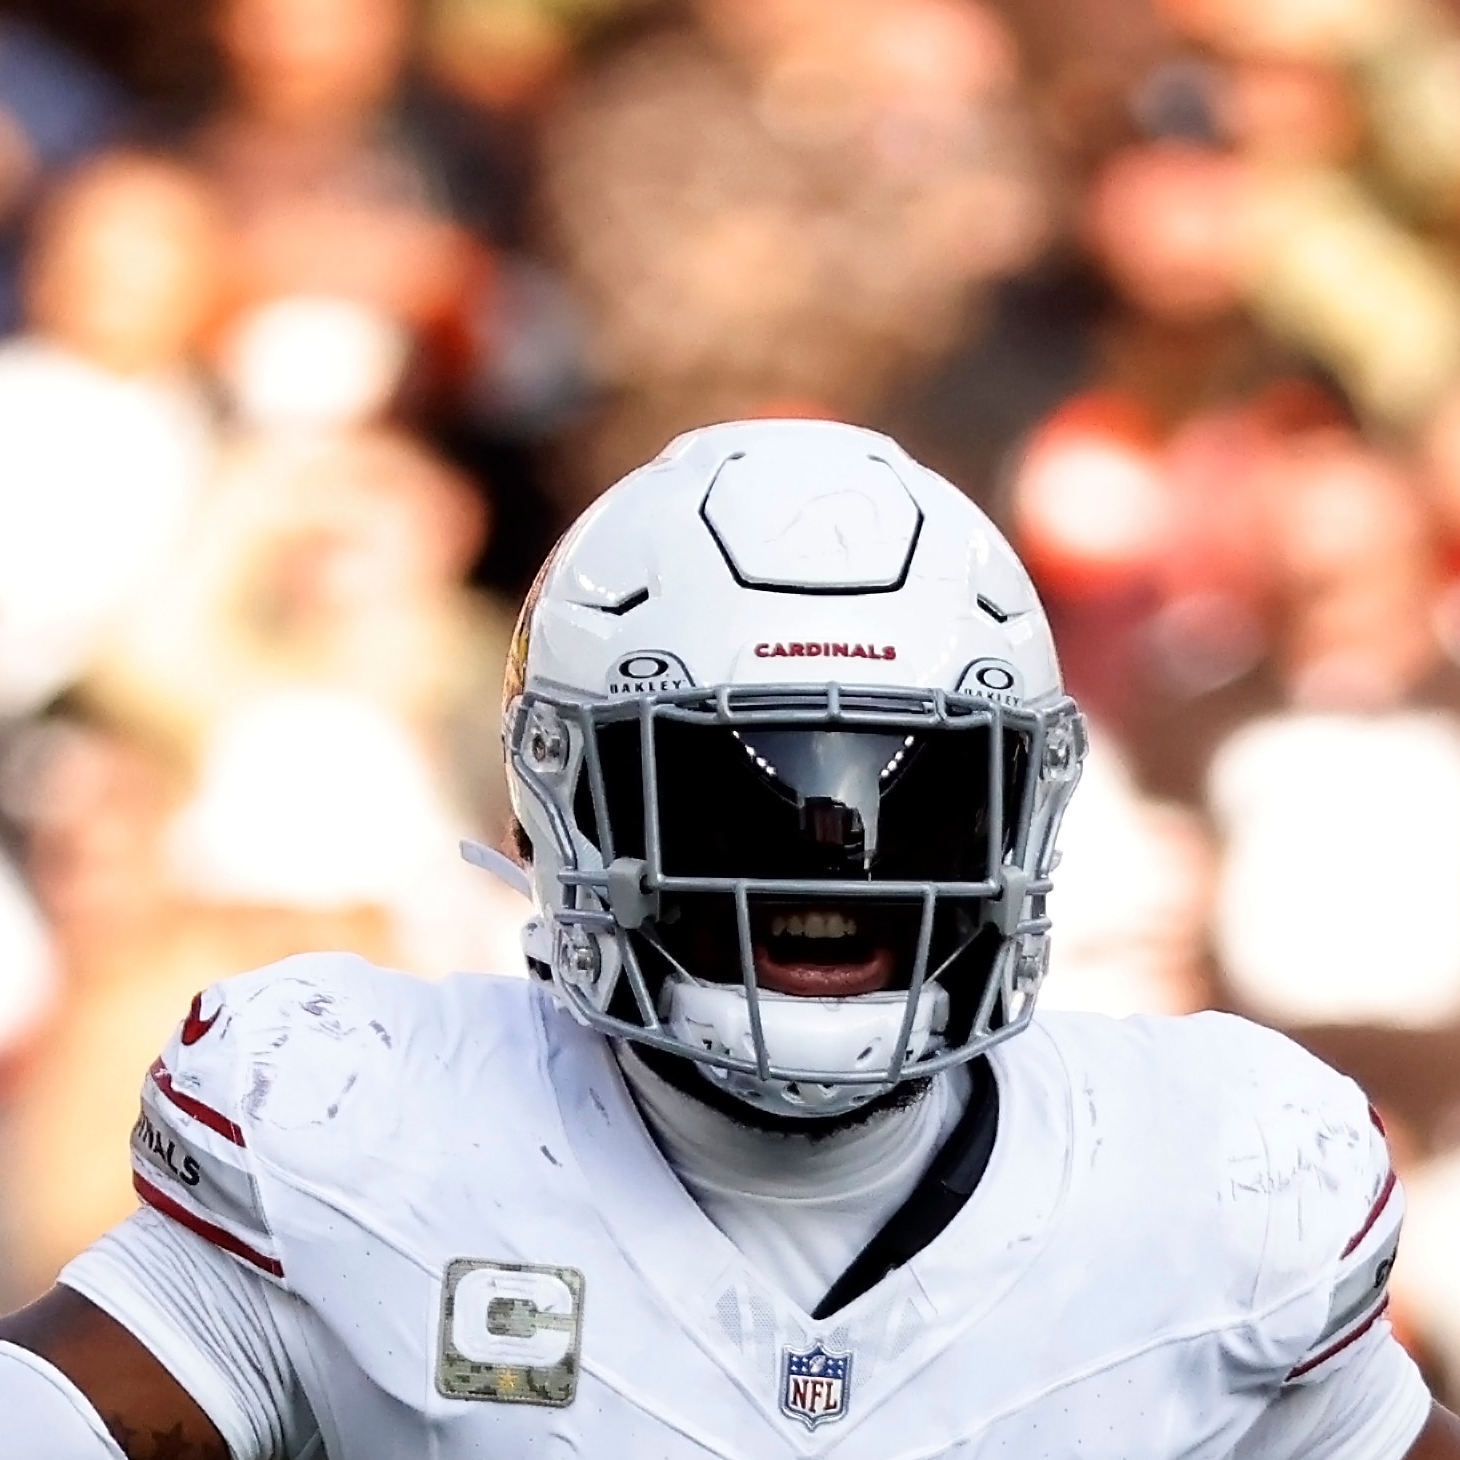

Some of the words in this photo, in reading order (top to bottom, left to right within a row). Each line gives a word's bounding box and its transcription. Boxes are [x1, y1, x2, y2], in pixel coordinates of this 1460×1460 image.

[753, 642, 897, 661] CARDINALS
[609, 680, 682, 694] OAKLEY
[451, 1267, 574, 1367] C
[790, 1378, 838, 1413] NFL
